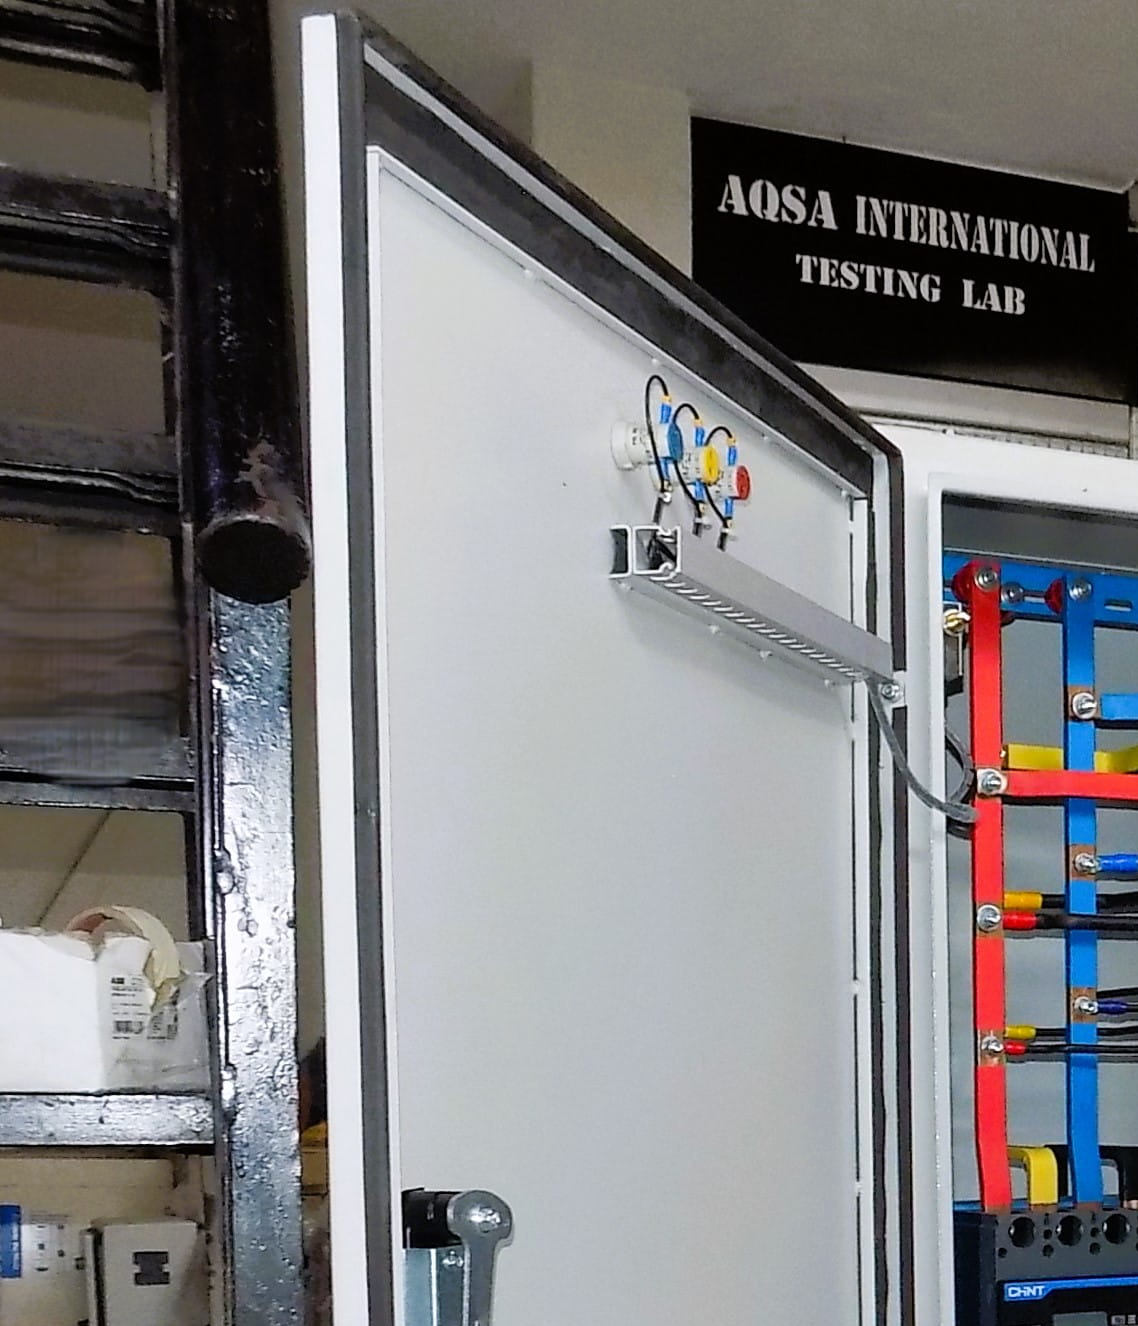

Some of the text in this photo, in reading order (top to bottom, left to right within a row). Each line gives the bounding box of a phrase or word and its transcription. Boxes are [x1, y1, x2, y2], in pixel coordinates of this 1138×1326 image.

[717, 174, 1095, 273] AQSA INTERNATIONAL
[795, 253, 1026, 315] TESTING LAB
